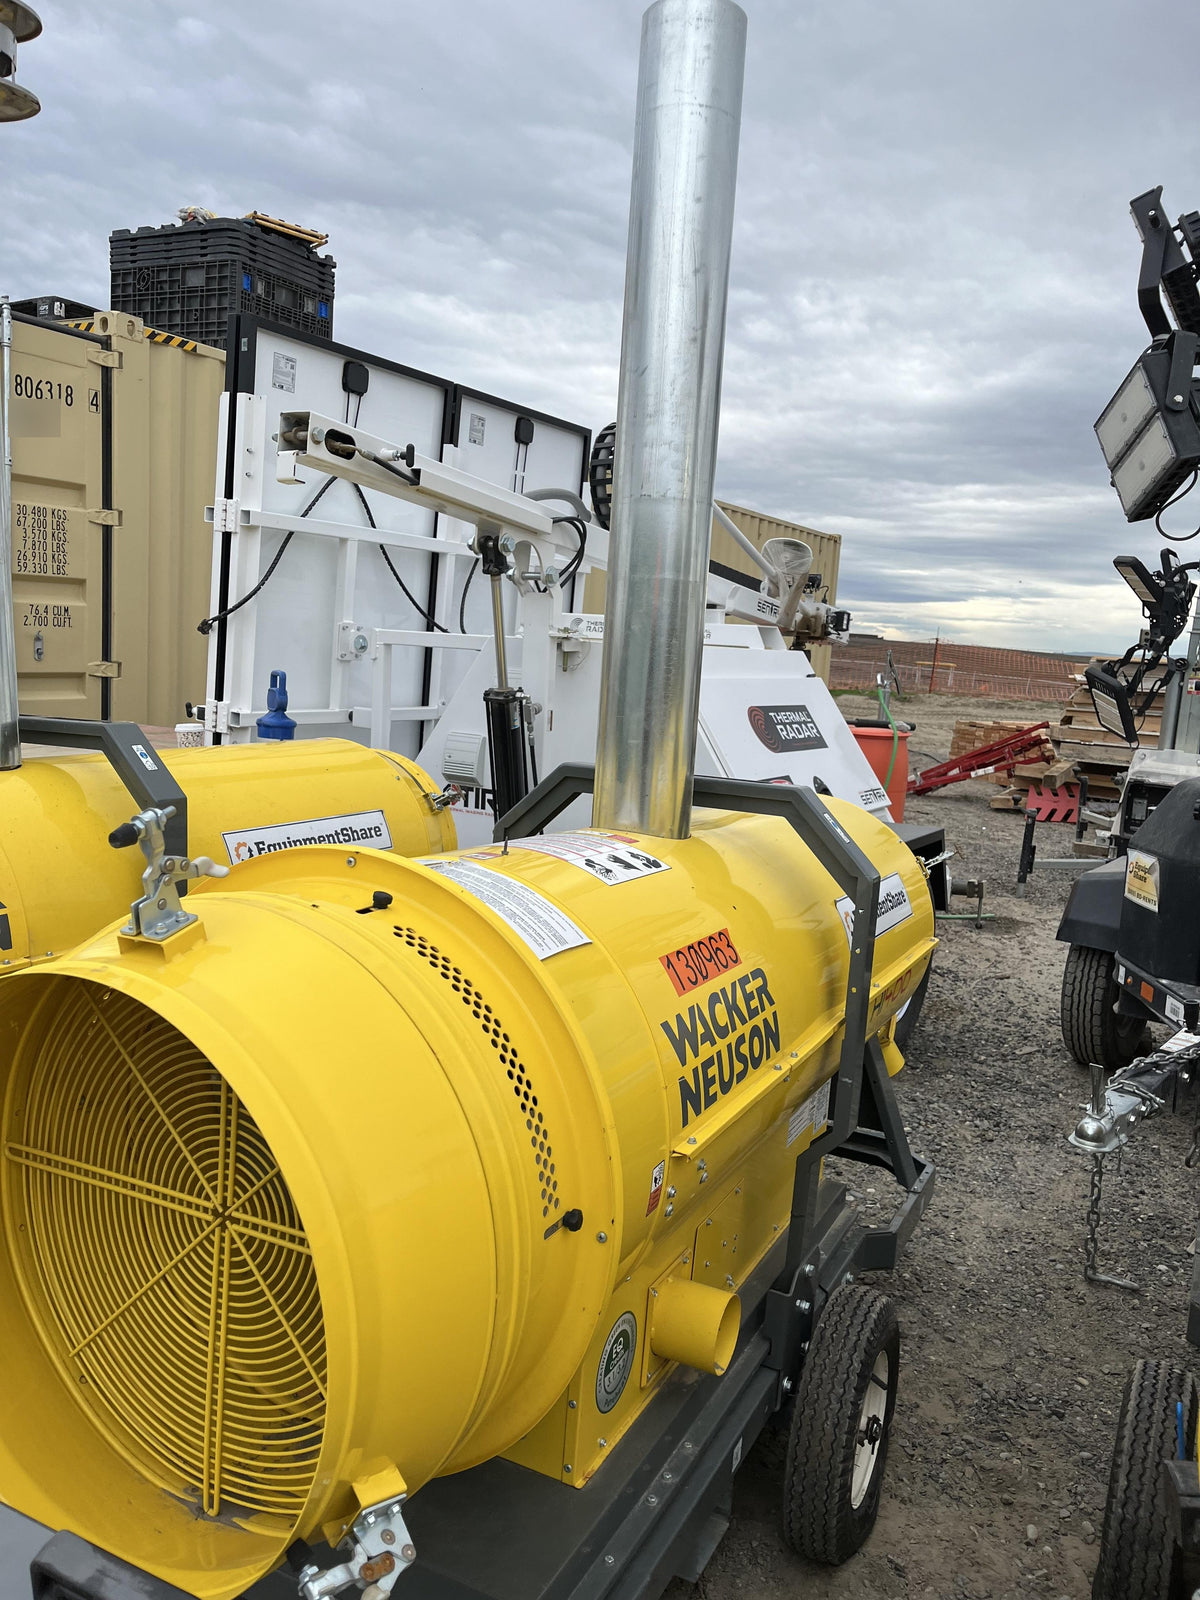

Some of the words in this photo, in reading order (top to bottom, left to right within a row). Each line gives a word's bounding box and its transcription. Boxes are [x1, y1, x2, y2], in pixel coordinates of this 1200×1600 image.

[14, 374, 74, 407] 806318
[90, 391, 99, 413] 4
[16, 504, 48, 518] 30.480
[51, 508, 70, 521] KGS.
[16, 516, 48, 530] 67.200
[51, 520, 68, 532] LBS.
[22, 527, 48, 541] 3.570
[51, 531, 70, 544] KGS.
[22, 539, 48, 552] 7.870
[51, 542, 68, 555] LBS.
[17, 549, 48, 563] 26.910
[51, 553, 70, 566] KGS.
[17, 561, 48, 574] 59.330
[51, 564, 69, 576] LBS.
[29, 604, 49, 616] 76.4
[23, 614, 49, 627] 2.700
[768, 711, 812, 724] THERMAL
[775, 723, 821, 741] RADAR
[666, 931, 739, 991] 130963
[660, 967, 776, 1068] WACKER
[678, 1010, 781, 1129] NEUSON
